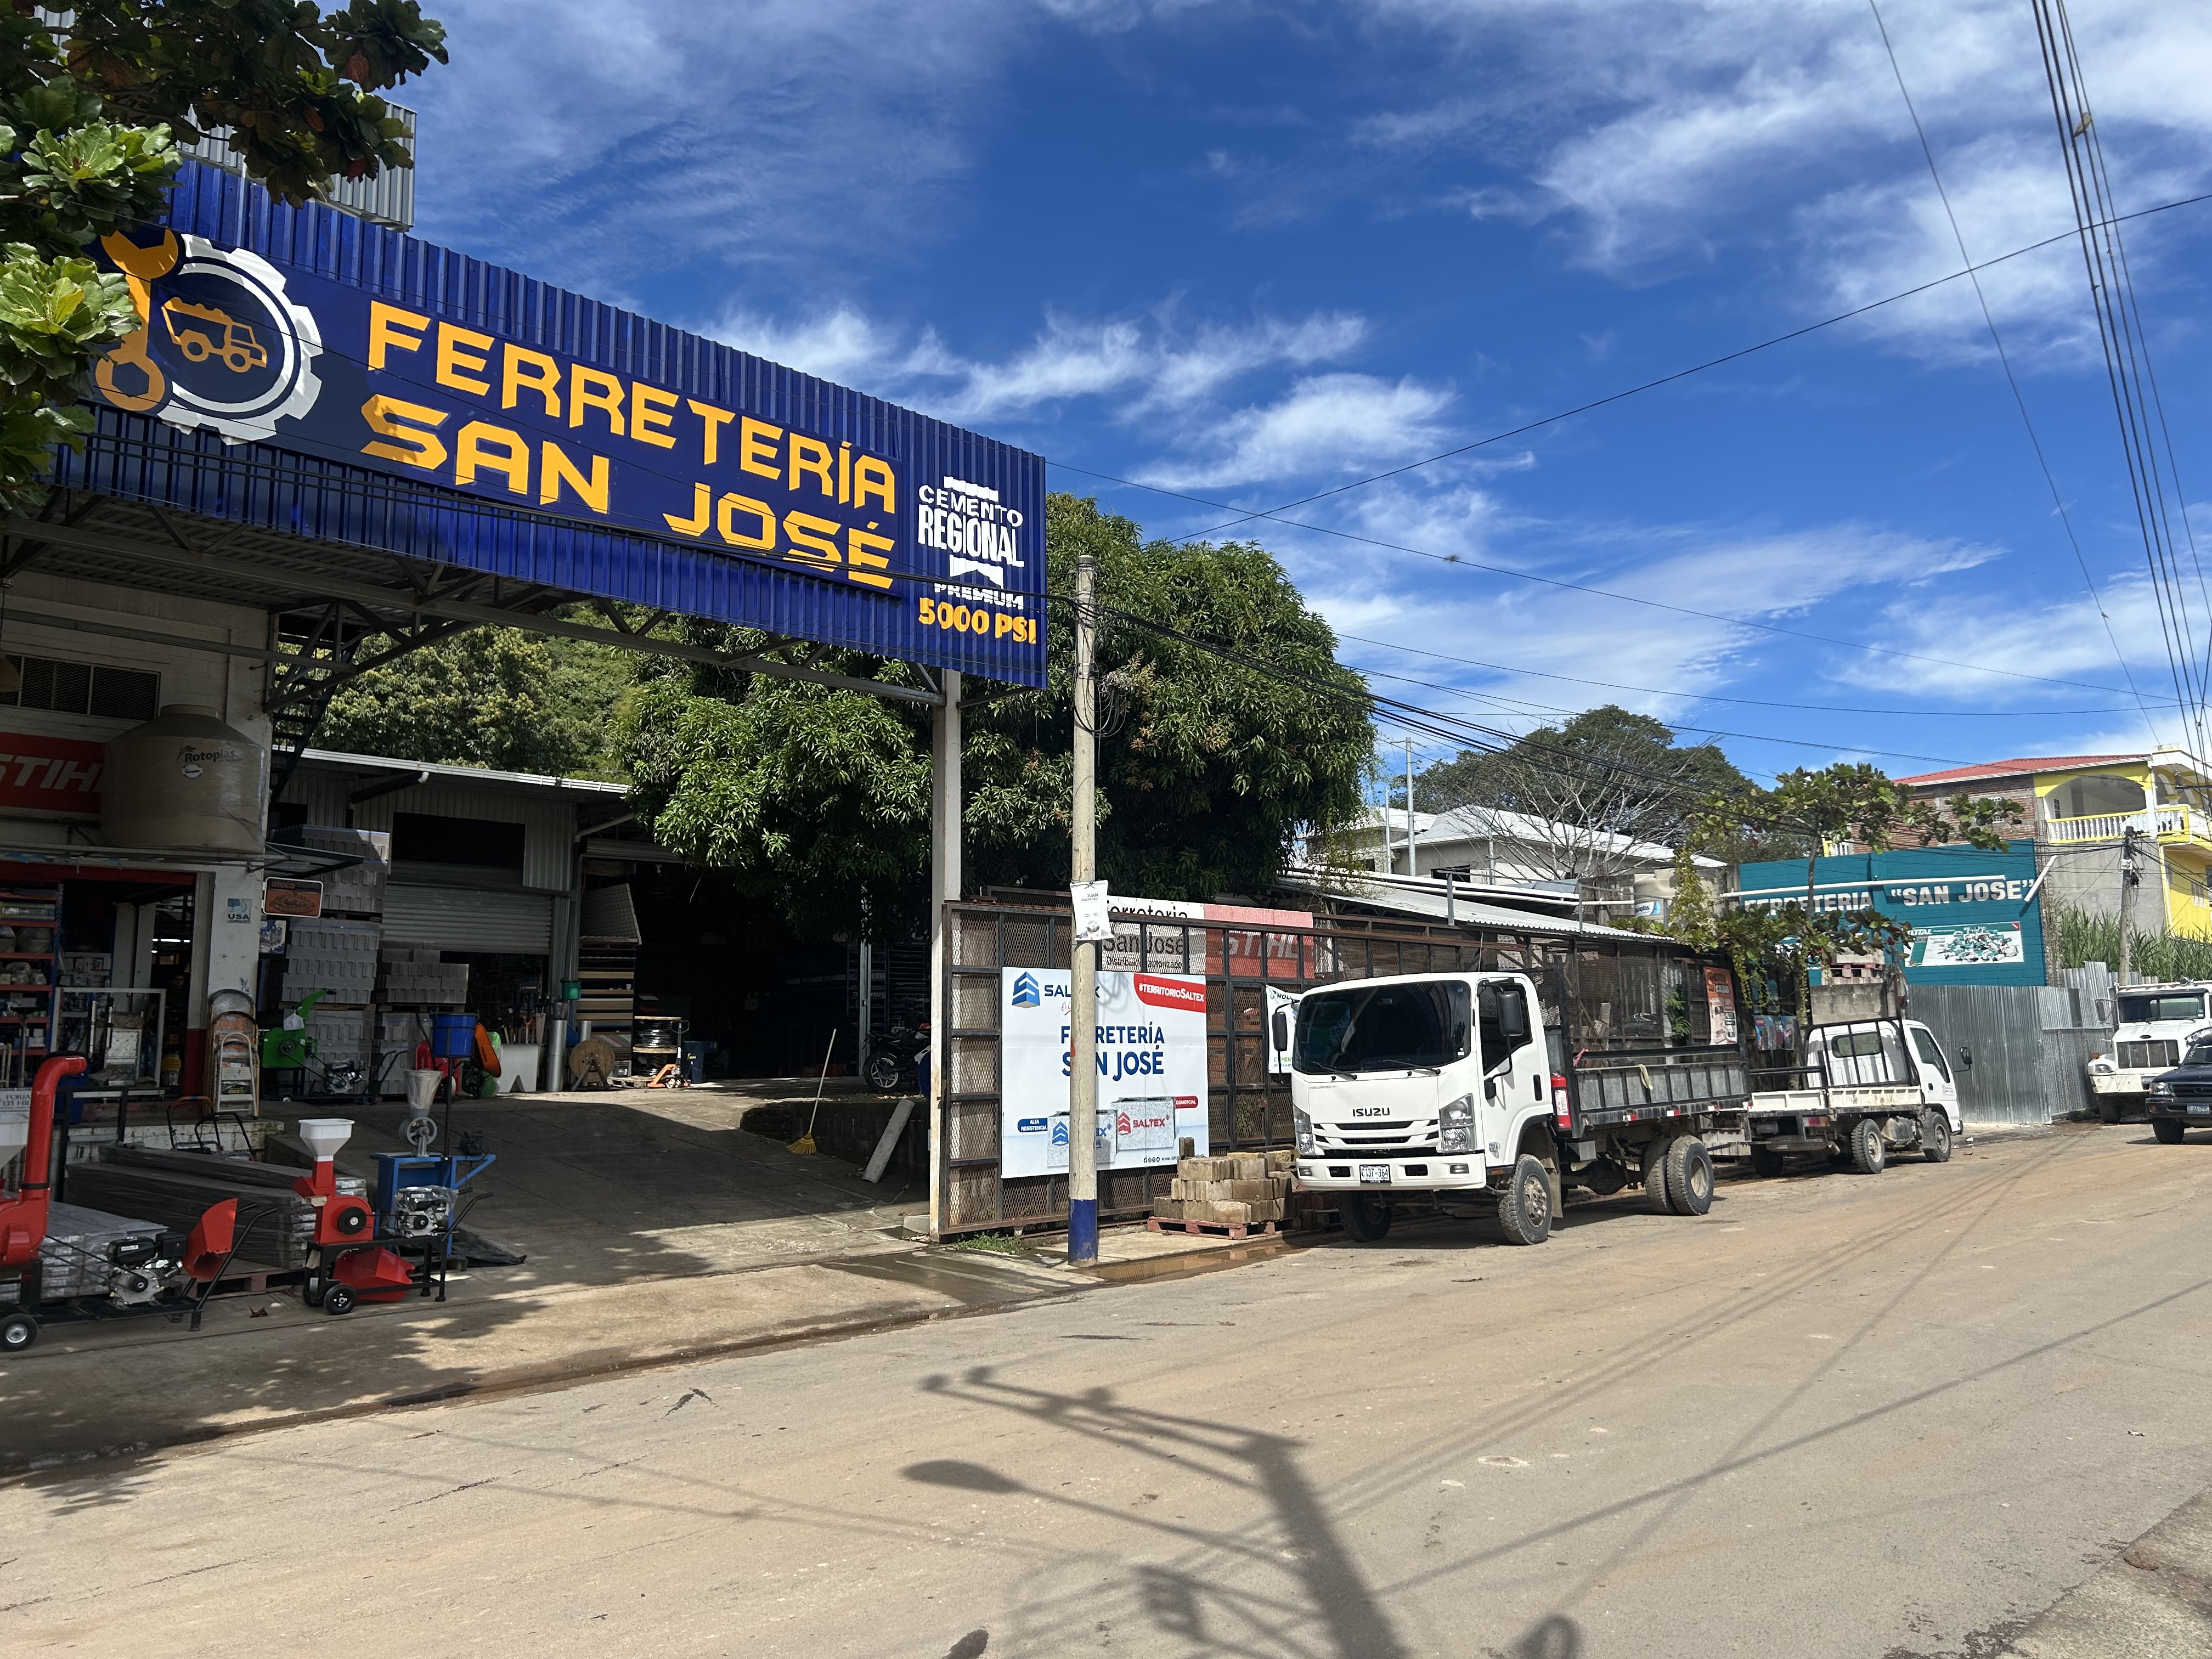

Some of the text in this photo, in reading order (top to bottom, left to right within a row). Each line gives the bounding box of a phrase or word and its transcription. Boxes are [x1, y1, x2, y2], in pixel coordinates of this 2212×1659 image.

[367, 300, 895, 514] FERRETERÍA
[360, 394, 895, 589] SAN JOSÉ
[918, 484, 1023, 527] CEMENTO
[918, 504, 1025, 567] REGIONAL
[934, 583, 1024, 610] PREMIUM
[918, 597, 1036, 644] 5000 PSI
[184, 749, 235, 763] Rotoplas
[0, 753, 102, 793] TIH
[1103, 934, 1139, 953] San
[1107, 957, 1141, 967] Distribuid
[1045, 984, 1101, 998] SALX
[1061, 1021, 1165, 1044] FRETERÍA
[1062, 1045, 1164, 1081] SN JOSÉ
[1133, 1118, 1166, 1128] SALTEX
[1352, 1107, 1390, 1117] ISUZU
